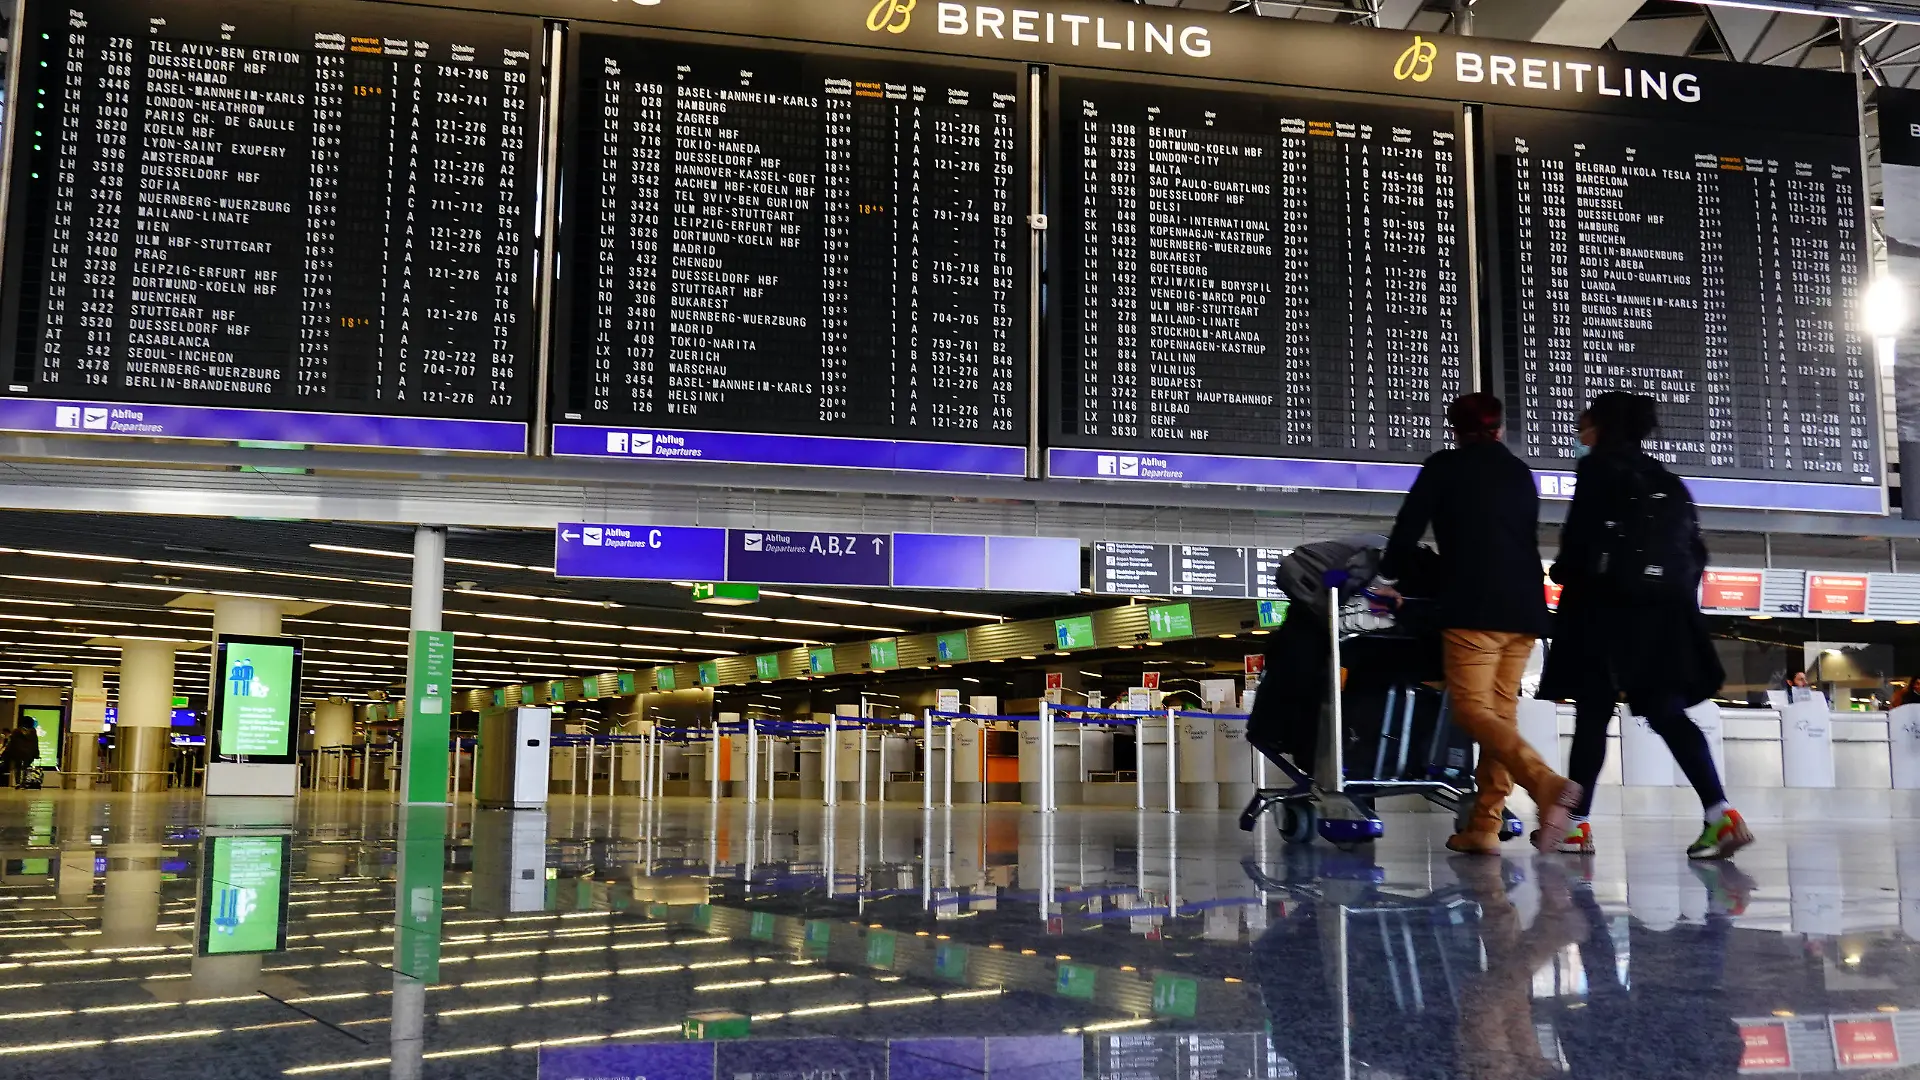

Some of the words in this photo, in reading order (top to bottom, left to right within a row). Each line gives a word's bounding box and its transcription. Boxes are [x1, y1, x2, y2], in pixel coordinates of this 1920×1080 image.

[937, 2, 1211, 58] BREITLING
[148, 53, 236, 72] DUESSELDORF
[243, 62, 267, 75] HBF
[149, 40, 173, 53] TEL
[180, 43, 246, 60] AVIV-BEN
[437, 65, 489, 81] 794-796
[503, 71, 526, 84] B20
[1455, 51, 1701, 103] BREITLING
[146, 81, 306, 105] BASEL-MANNHEIM-KARLS
[147, 67, 228, 85] DOHA-HAMAD
[436, 91, 488, 107] 734-741
[502, 97, 525, 111] B42
[677, 85, 818, 109] BASEL-MANNHEIM-KARLS
[145, 95, 266, 116] LONDON-HEATHROW
[144, 108, 185, 123] PARIS
[224, 115, 241, 128] DE
[248, 116, 296, 132] GAULLE
[676, 98, 727, 114] HAMBURG
[934, 120, 981, 135] 121-276
[993, 125, 1013, 138] A11
[676, 111, 720, 126] ZAGREB
[143, 122, 185, 137] KOELN
[191, 126, 216, 139] HBF
[675, 124, 712, 138] KOELN
[718, 128, 740, 140] HBF
[1148, 125, 1188, 140] BEIRUT
[143, 136, 224, 153] LYON-SAINT
[231, 143, 287, 158] EXUPERY
[675, 137, 761, 155] TOKIO-HANEDA
[141, 150, 215, 167] AMSTERDAM
[675, 150, 753, 167] DUESSELDORF
[760, 157, 781, 169] HBF
[674, 163, 817, 185] HANNOVER-KASSEL-GOET
[1149, 150, 1220, 167] LONDON-CITY
[1381, 169, 1424, 184] 445-446
[1435, 174, 1454, 186] B47
[1575, 161, 1617, 175] BELGRAD
[1621, 165, 1657, 178] NIKOLA
[1661, 168, 1692, 181] TESLA
[139, 177, 181, 192] SOFIA
[1148, 163, 1182, 176] MALTA
[1381, 181, 1424, 195] 733-736
[1435, 186, 1454, 198] A19
[1149, 175, 1169, 187] SAO
[1174, 177, 1271, 195] PAULO-GUARTLHOS
[1575, 173, 1629, 188] BARCELONA
[1576, 185, 1624, 199] WARSCHAU
[138, 191, 291, 214] NUERNBERG-WUERZBURG
[1576, 196, 1624, 210] BRUESSEL
[137, 205, 250, 225] MAILAND-LINATE
[1149, 200, 1181, 213] DELSI
[1382, 217, 1426, 231] 501-505
[1149, 212, 1270, 232] DUBAI-INTERNATIONAL
[1577, 208, 1642, 223] DUESSELDORF
[1647, 214, 1665, 225] HBF
[136, 219, 170, 233] WIEN
[673, 216, 773, 233] LEIPZIG-ERFURT
[780, 223, 801, 235] HBF
[1577, 220, 1620, 234] HAMBURG
[135, 233, 160, 246] ULM
[167, 235, 273, 254] HBF-STUTTGART
[1149, 237, 1272, 256] NUERNBERG-WUERZBURG
[1578, 232, 1626, 246] MUENCHEN
[134, 247, 168, 261] PRAG
[672, 242, 716, 256] MADRID
[1149, 249, 1202, 264] BUKAREST
[1578, 244, 1684, 262] BERLIN-BRANDENBURG
[672, 255, 723, 270] CHENGDU
[1149, 262, 1208, 277] GOETEBORG
[1579, 256, 1610, 268] ADDIS
[1614, 258, 1645, 270] ABEBA
[1150, 275, 1215, 289] KYJIW/KIEW
[1220, 279, 1272, 293] BORYSPIL
[1580, 267, 1599, 279] SAO
[1603, 269, 1692, 286] PAULO-GUARTLHOS
[671, 282, 736, 297] STUTTGART
[743, 286, 764, 299] HBF
[1580, 280, 1617, 292] LUANDA
[131, 290, 197, 305] MUENCHEN
[670, 295, 729, 310] BUKAREST
[1150, 287, 1234, 303] VENEDIG-MARCO
[1240, 293, 1266, 305] POLO
[1581, 291, 1698, 310] BASEL-MANNHEIM-KARLS
[1150, 300, 1170, 312] ULM
[1176, 301, 1260, 317] HBF-STUTTGART
[1581, 303, 1618, 316] BUENOS
[1622, 306, 1653, 319] AIRES
[670, 308, 807, 328] NUERNBERG-WUERZBURG
[1150, 312, 1240, 329] MAILAND-LINATE
[1582, 316, 1653, 330] JOHANNESBURG
[128, 332, 211, 348] CASABLANCA
[1150, 325, 1261, 342] STOCKHOLM-ARLANDA
[1582, 327, 1625, 340] NANJING
[669, 335, 757, 351] TOKIO-NARITA
[1150, 337, 1267, 355] KOPENHAGEN-KASTRUP
[1582, 340, 1614, 352] KOELN
[1617, 342, 1636, 353] HBF
[127, 346, 234, 364] SEOUL-INCHEON
[669, 348, 720, 363] ZUERICH
[1150, 350, 1196, 364] TALLINN
[1583, 352, 1608, 364] WIEN
[668, 362, 727, 377] WARSCHAU
[1149, 363, 1196, 377] VILNIUS
[1583, 364, 1603, 375] ULM
[1607, 365, 1684, 380] HBF-STUTTGART
[125, 375, 272, 394] BERLIN-BRANDENBURG
[1150, 376, 1203, 389] BUDAPEST
[1584, 376, 1615, 388] PARIS
[1643, 379, 1656, 390] DE
[1660, 380, 1696, 393] GAULLE
[667, 389, 725, 403] HELSINKI
[1150, 388, 1190, 401] ERFURT
[1196, 391, 1274, 406] HAUPTBAHNHOF
[111, 409, 143, 421] Abflug
[667, 402, 697, 415] WIEN
[1150, 401, 1190, 414] BILBAO
[110, 420, 164, 432] Departures
[1150, 414, 1177, 426] GENF
[655, 434, 685, 446] Abflug
[1150, 427, 1184, 439] KOELN
[1190, 429, 1209, 441] HBF
[655, 445, 702, 457] Departures
[1141, 457, 1167, 469] Abflug
[1141, 467, 1183, 479] Departures
[605, 528, 631, 539] Abflug
[605, 538, 646, 549] Departures
[649, 529, 662, 549] C
[765, 533, 791, 544] Abflug
[765, 543, 806, 553] Departures
[809, 535, 857, 557] A,B,Z
